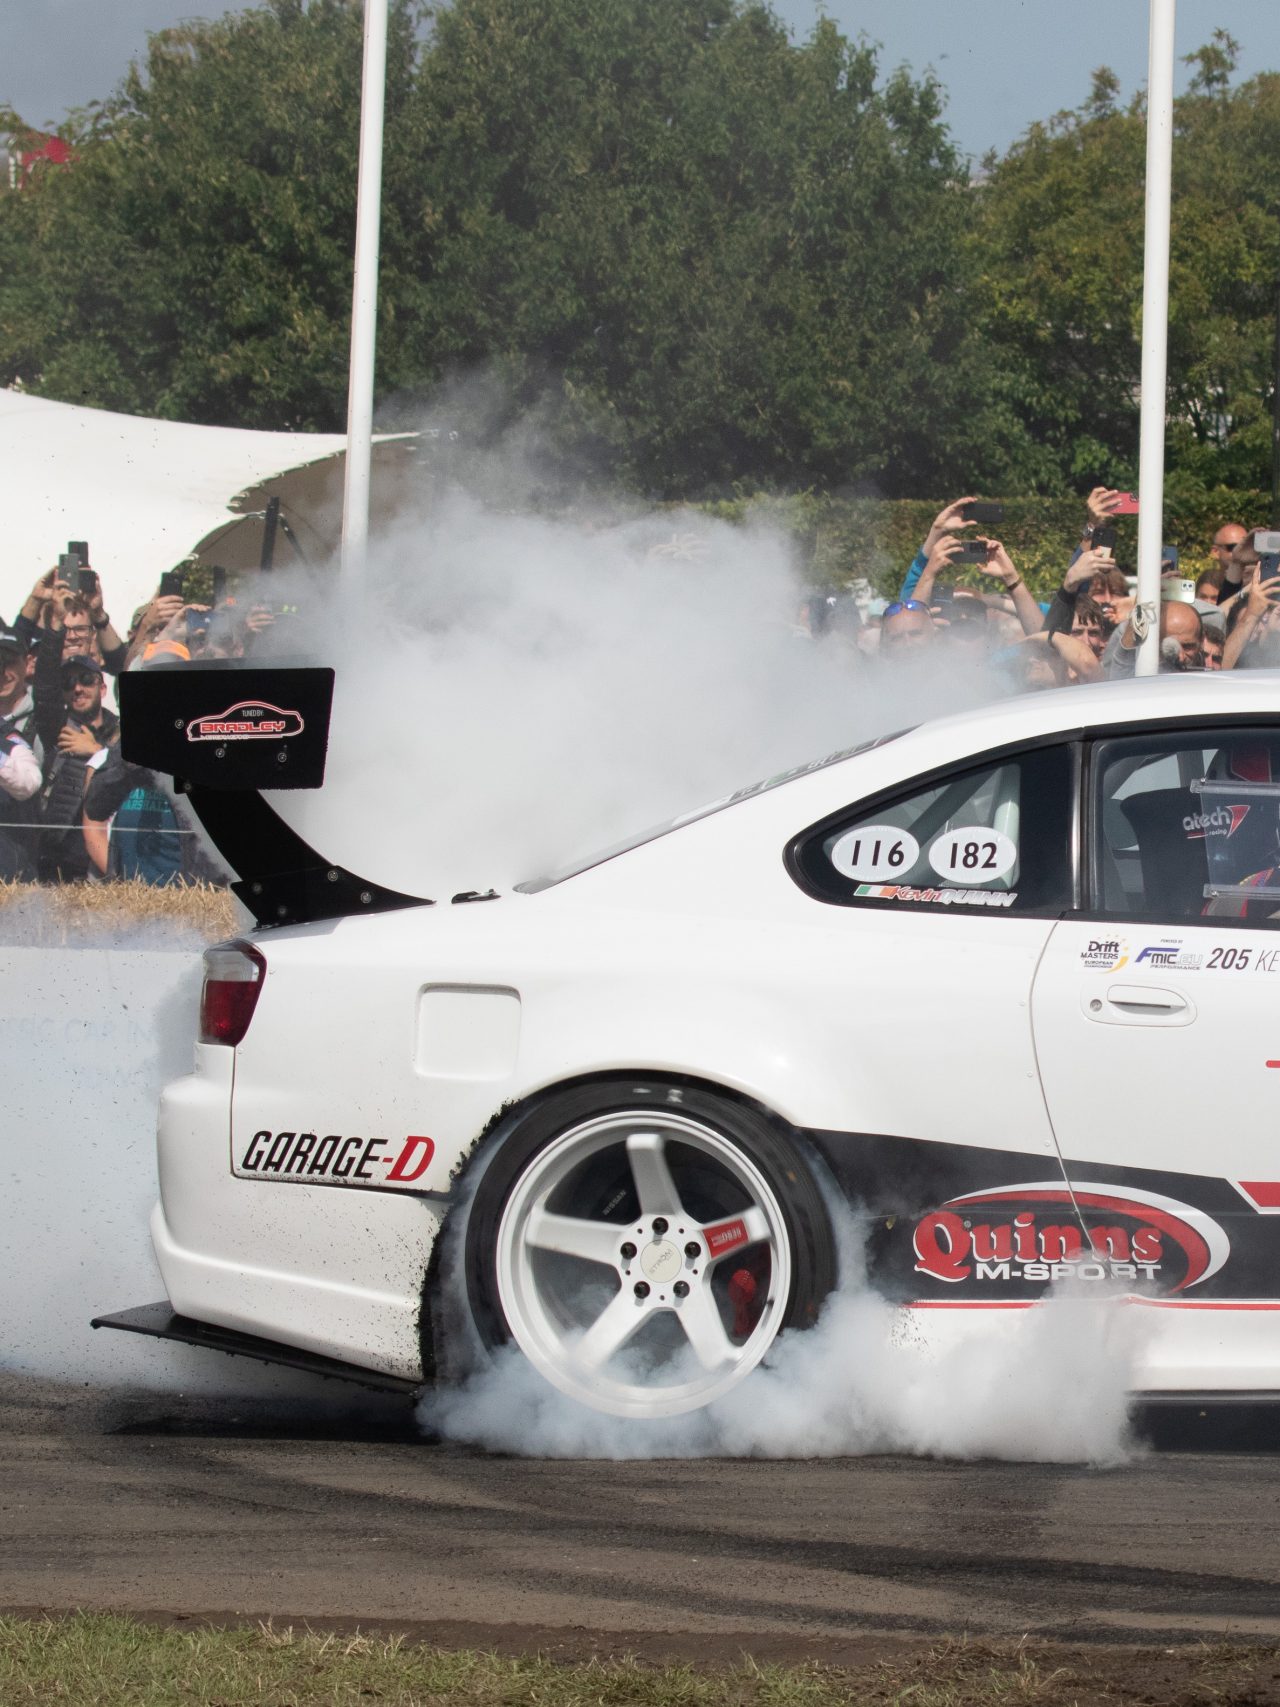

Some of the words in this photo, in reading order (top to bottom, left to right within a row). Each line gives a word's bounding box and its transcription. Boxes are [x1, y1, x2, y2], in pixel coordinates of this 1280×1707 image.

[200, 721, 285, 733] BRADLEY
[1182, 806, 1231, 831] atech
[851, 840, 905, 867] 116
[950, 842, 998, 869] 182
[893, 886, 942, 903] Kevin
[1080, 952, 1119, 960] MASTERS
[1088, 940, 1120, 953] Drift
[1206, 948, 1253, 971] 205
[241, 1130, 435, 1182] GARAGE-D
[913, 1211, 1164, 1282] Quinns
[975, 1263, 1162, 1281] M-SPORT
